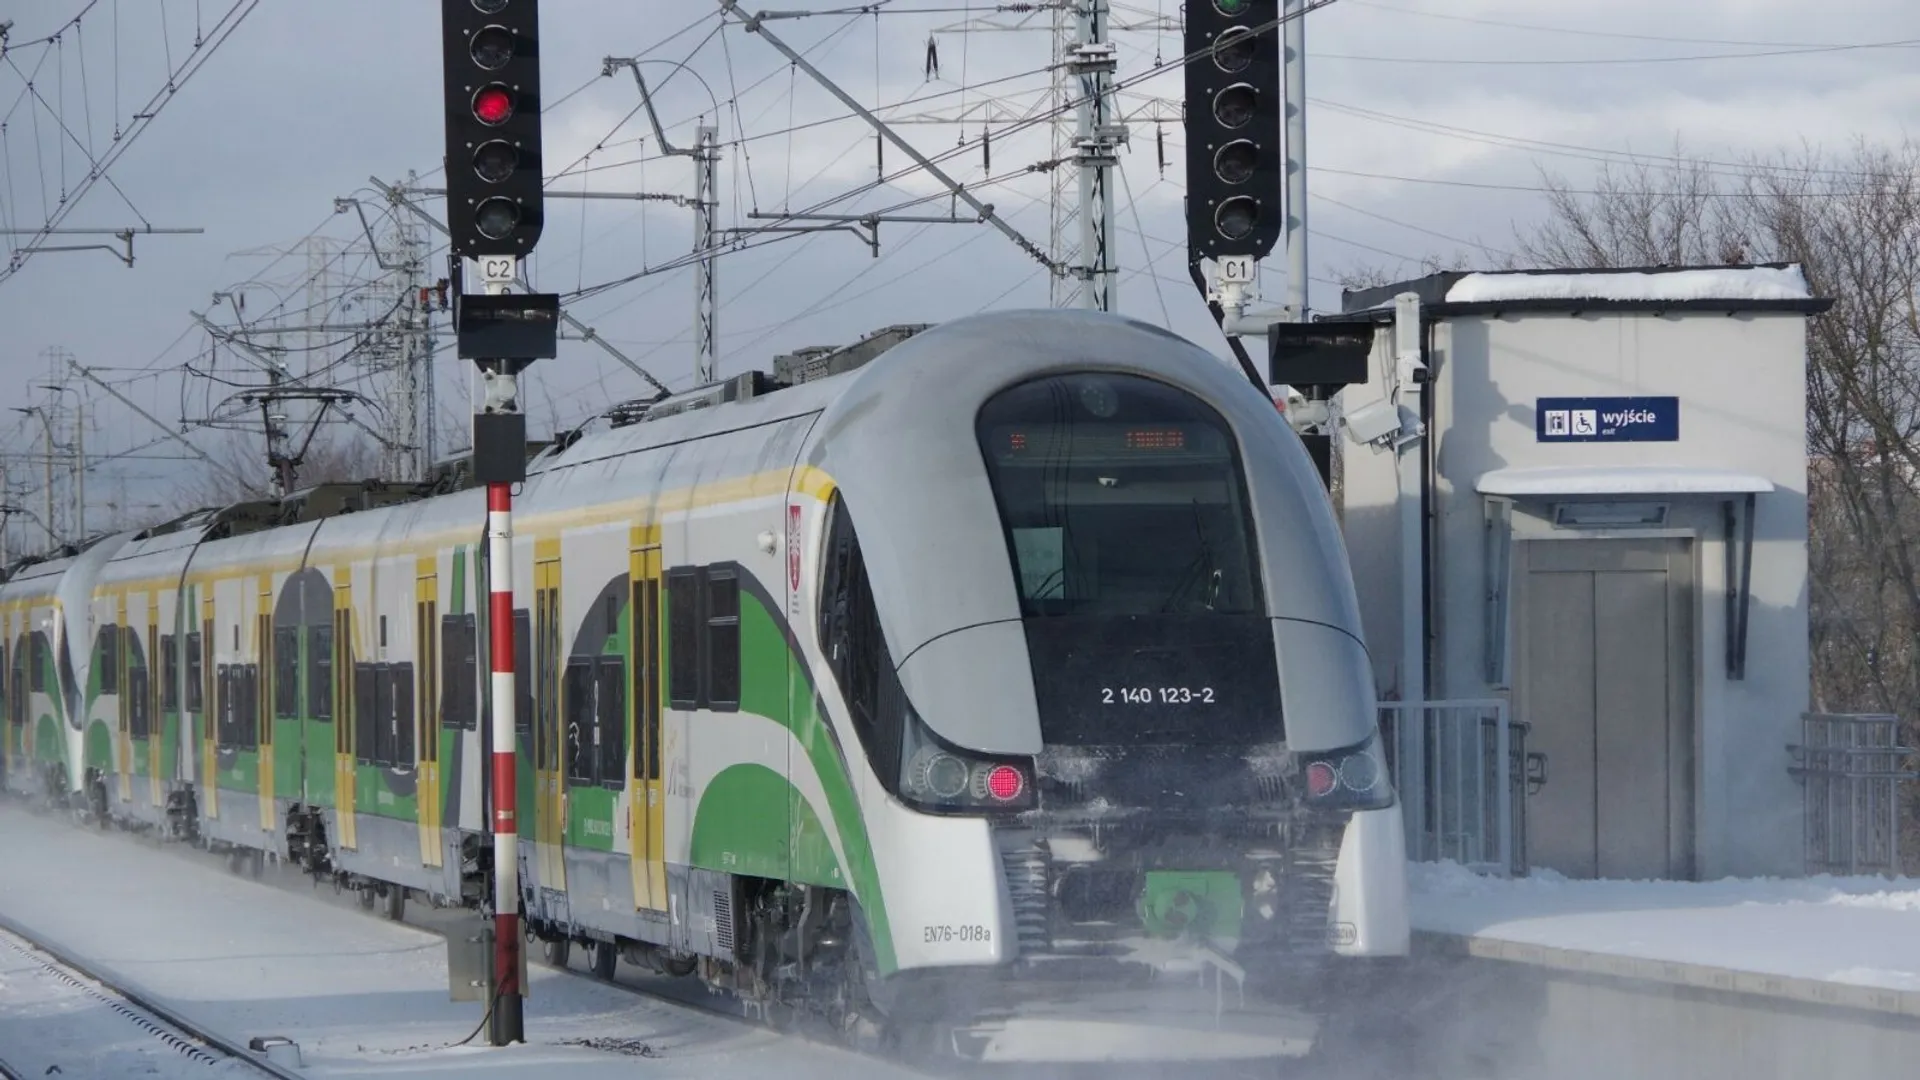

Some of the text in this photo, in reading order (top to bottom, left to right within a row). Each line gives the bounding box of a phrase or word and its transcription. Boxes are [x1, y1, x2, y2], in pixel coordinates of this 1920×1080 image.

[487, 260, 510, 278] C2
[1226, 261, 1245, 278] C1
[1602, 409, 1656, 427] wyjście
[1101, 687, 1215, 704] 2 140 123-2
[924, 925, 991, 943] EN76-018a
